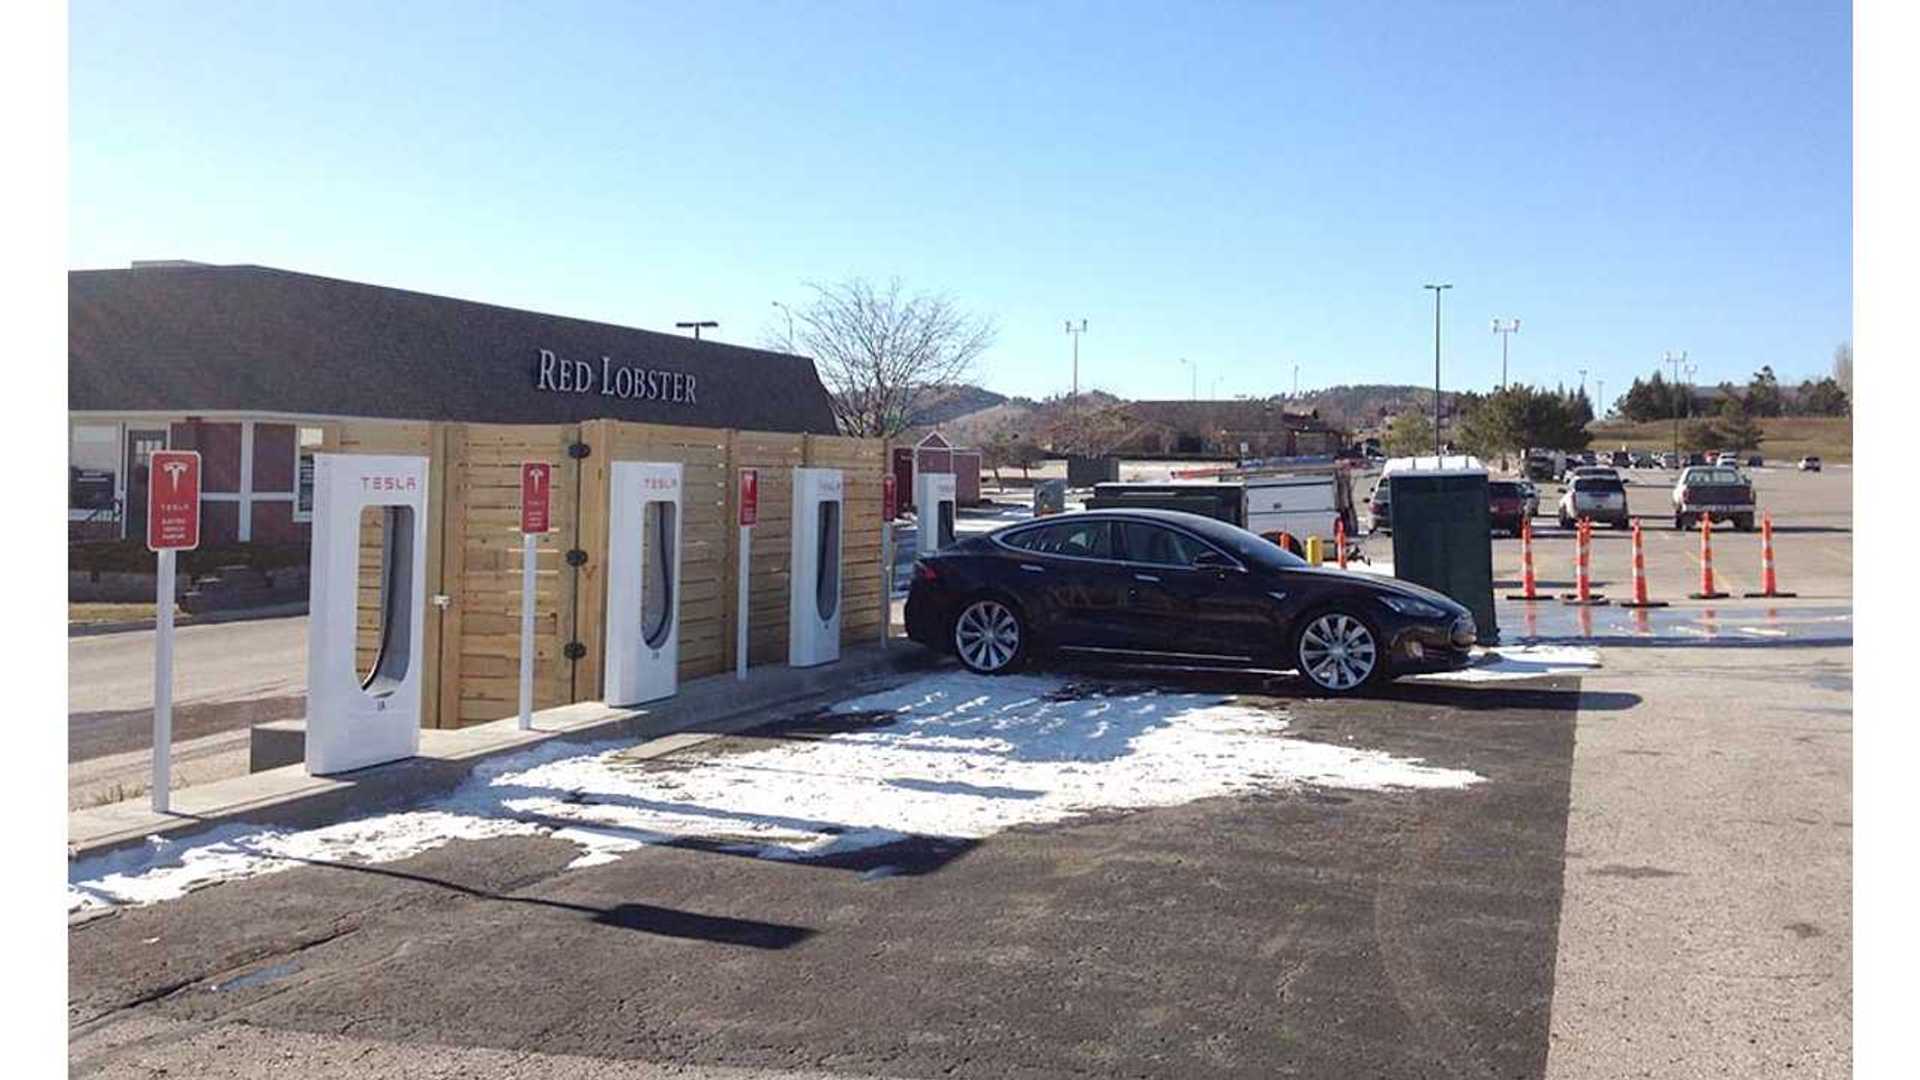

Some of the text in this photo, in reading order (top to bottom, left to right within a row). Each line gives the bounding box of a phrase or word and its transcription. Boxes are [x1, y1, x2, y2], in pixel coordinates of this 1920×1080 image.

[537, 348, 697, 403] RED LOBSTER
[360, 476, 417, 490] TESLA
